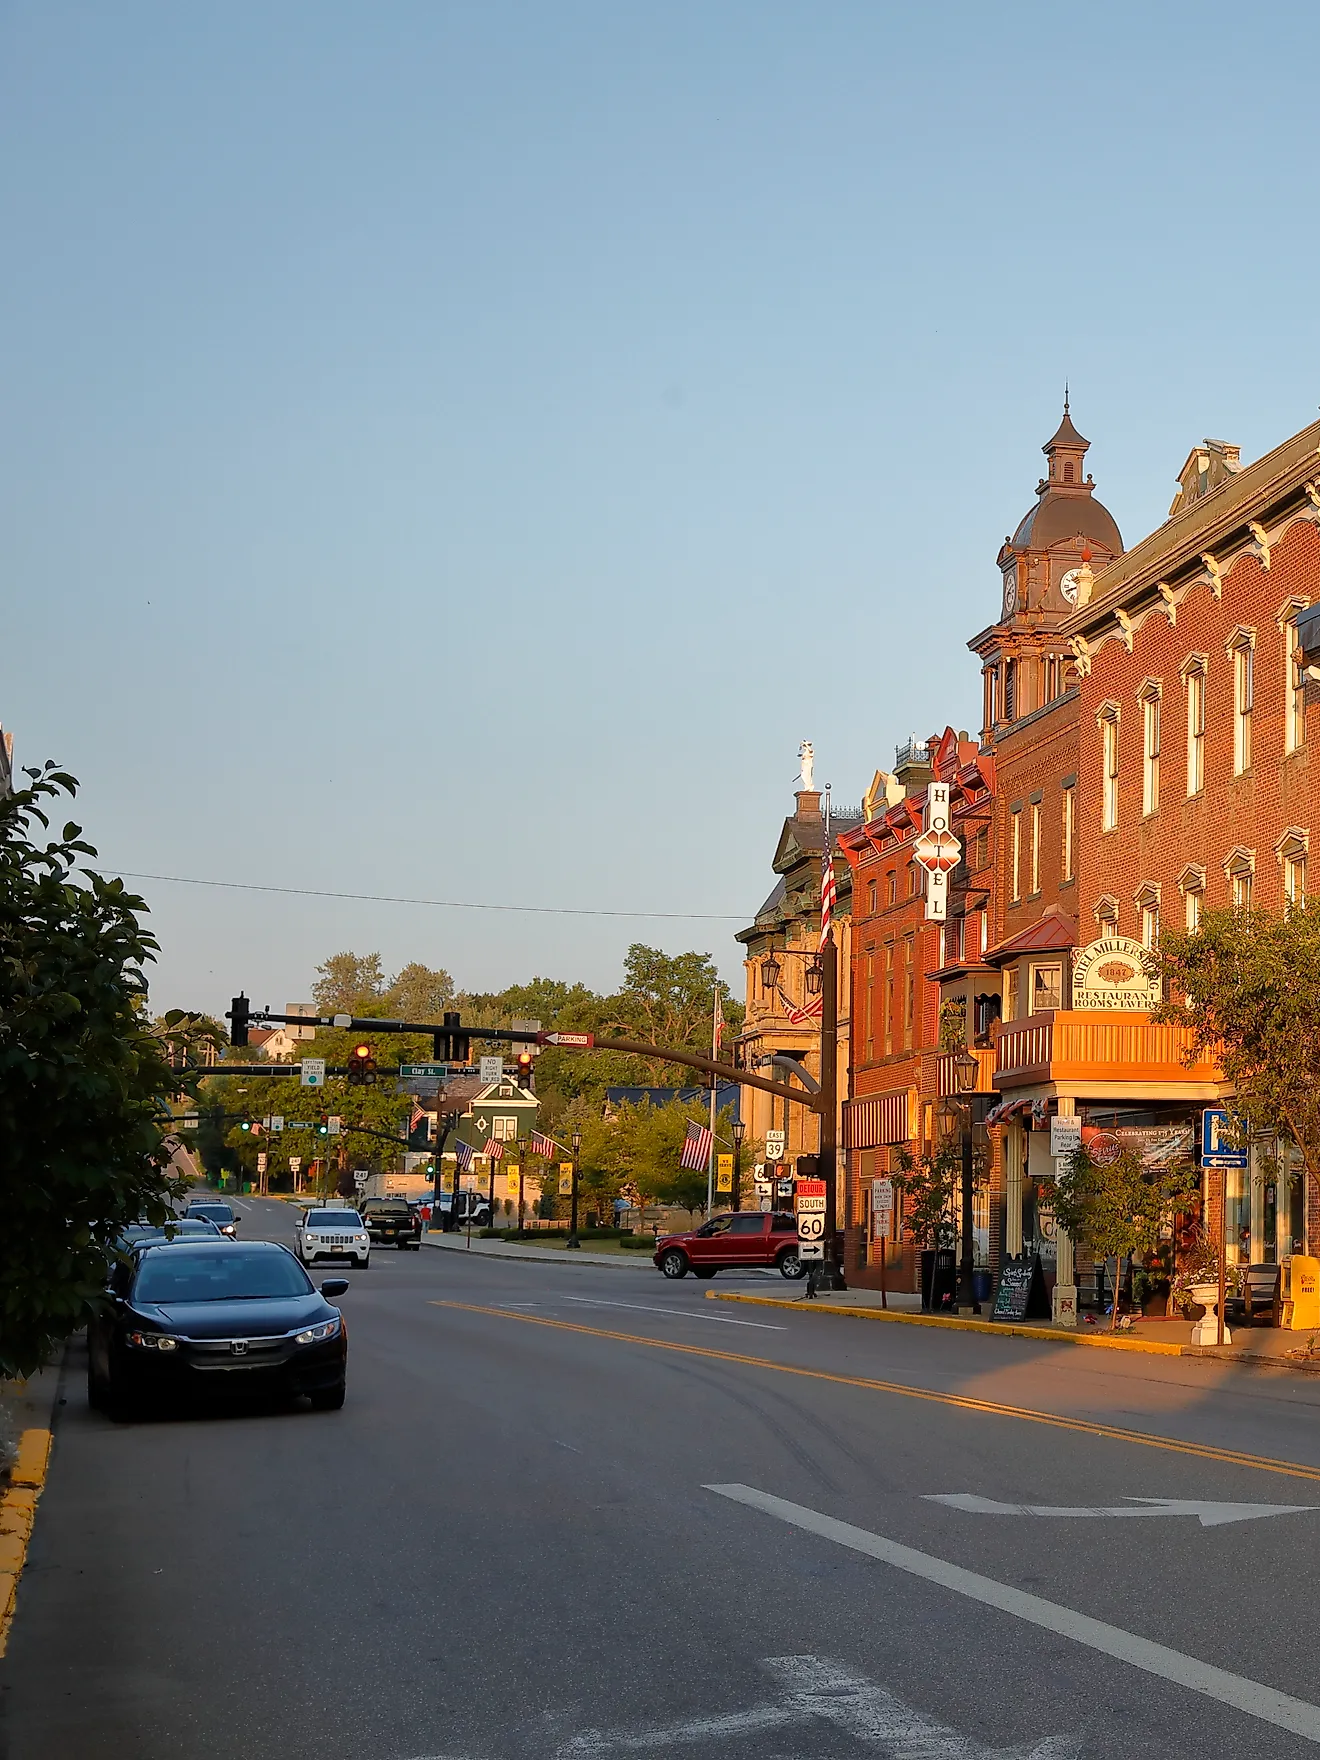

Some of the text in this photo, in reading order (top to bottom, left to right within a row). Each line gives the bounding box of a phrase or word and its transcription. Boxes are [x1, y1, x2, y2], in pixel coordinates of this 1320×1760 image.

[932, 789, 946, 914] HOTEL
[1073, 953, 1094, 989] HOTEL
[1106, 968, 1127, 976] 1847
[1077, 991, 1155, 1001] RESTAURANT
[1074, 999, 1113, 1008] ROOMS
[557, 1035, 586, 1043] PARKING
[411, 1068, 425, 1077] Clay
[768, 1144, 781, 1155] 39
[799, 1184, 824, 1193] DETOUR
[799, 1199, 824, 1208] SOUTH
[800, 1219, 822, 1235] 60
